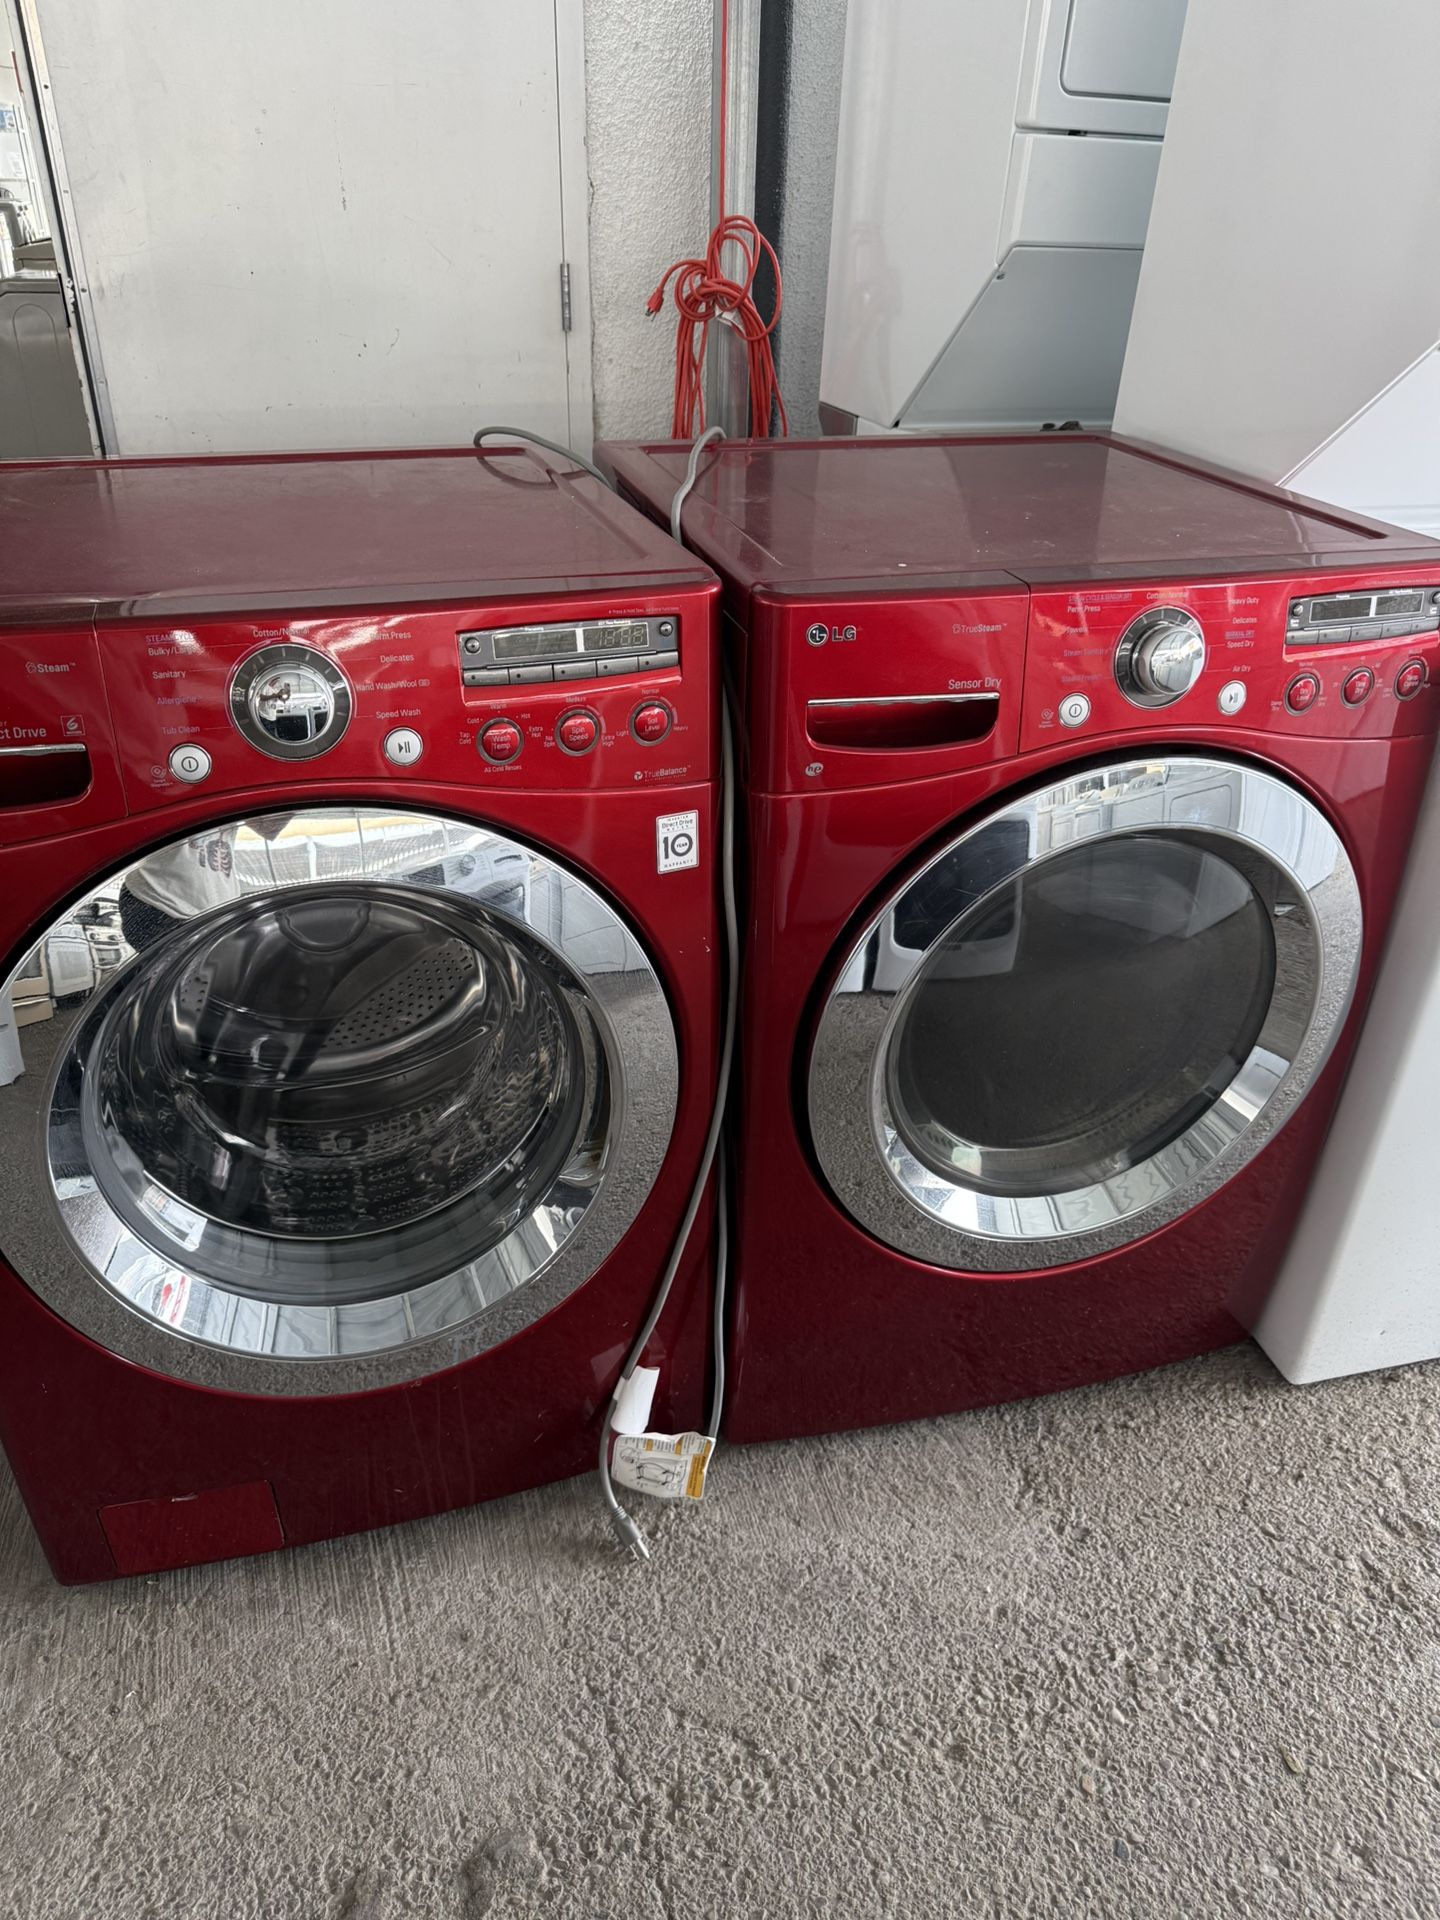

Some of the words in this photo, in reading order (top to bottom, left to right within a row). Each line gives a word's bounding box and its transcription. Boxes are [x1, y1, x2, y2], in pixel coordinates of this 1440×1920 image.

[1083, 604, 1101, 613] Press
[1232, 617, 1258, 625] Delicates
[390, 630, 412, 640] Press
[831, 625, 857, 642] LG
[1226, 641, 1245, 649] Speed
[1244, 639, 1255, 648] Dry
[380, 653, 415, 664] Delicates
[1240, 664, 1251, 673] Dry
[152, 670, 187, 680] Sanitary
[355, 683, 375, 692] Hand
[947, 677, 982, 690] Sensor
[984, 676, 1002, 689] Dry
[375, 709, 400, 720] Speed
[400, 708, 422, 717] Wash
[12, 727, 47, 739] Drive
[162, 727, 178, 736] Tub
[178, 726, 201, 736] Clean
[571, 727, 586, 735] Spin
[492, 735, 512, 743] Wash
[569, 733, 589, 742] Speed
[493, 742, 511, 751] Temp
[661, 821, 679, 829] Direct
[678, 818, 694, 826] Drive
[662, 832, 694, 860] 10
[663, 858, 694, 869] WARRANTY
